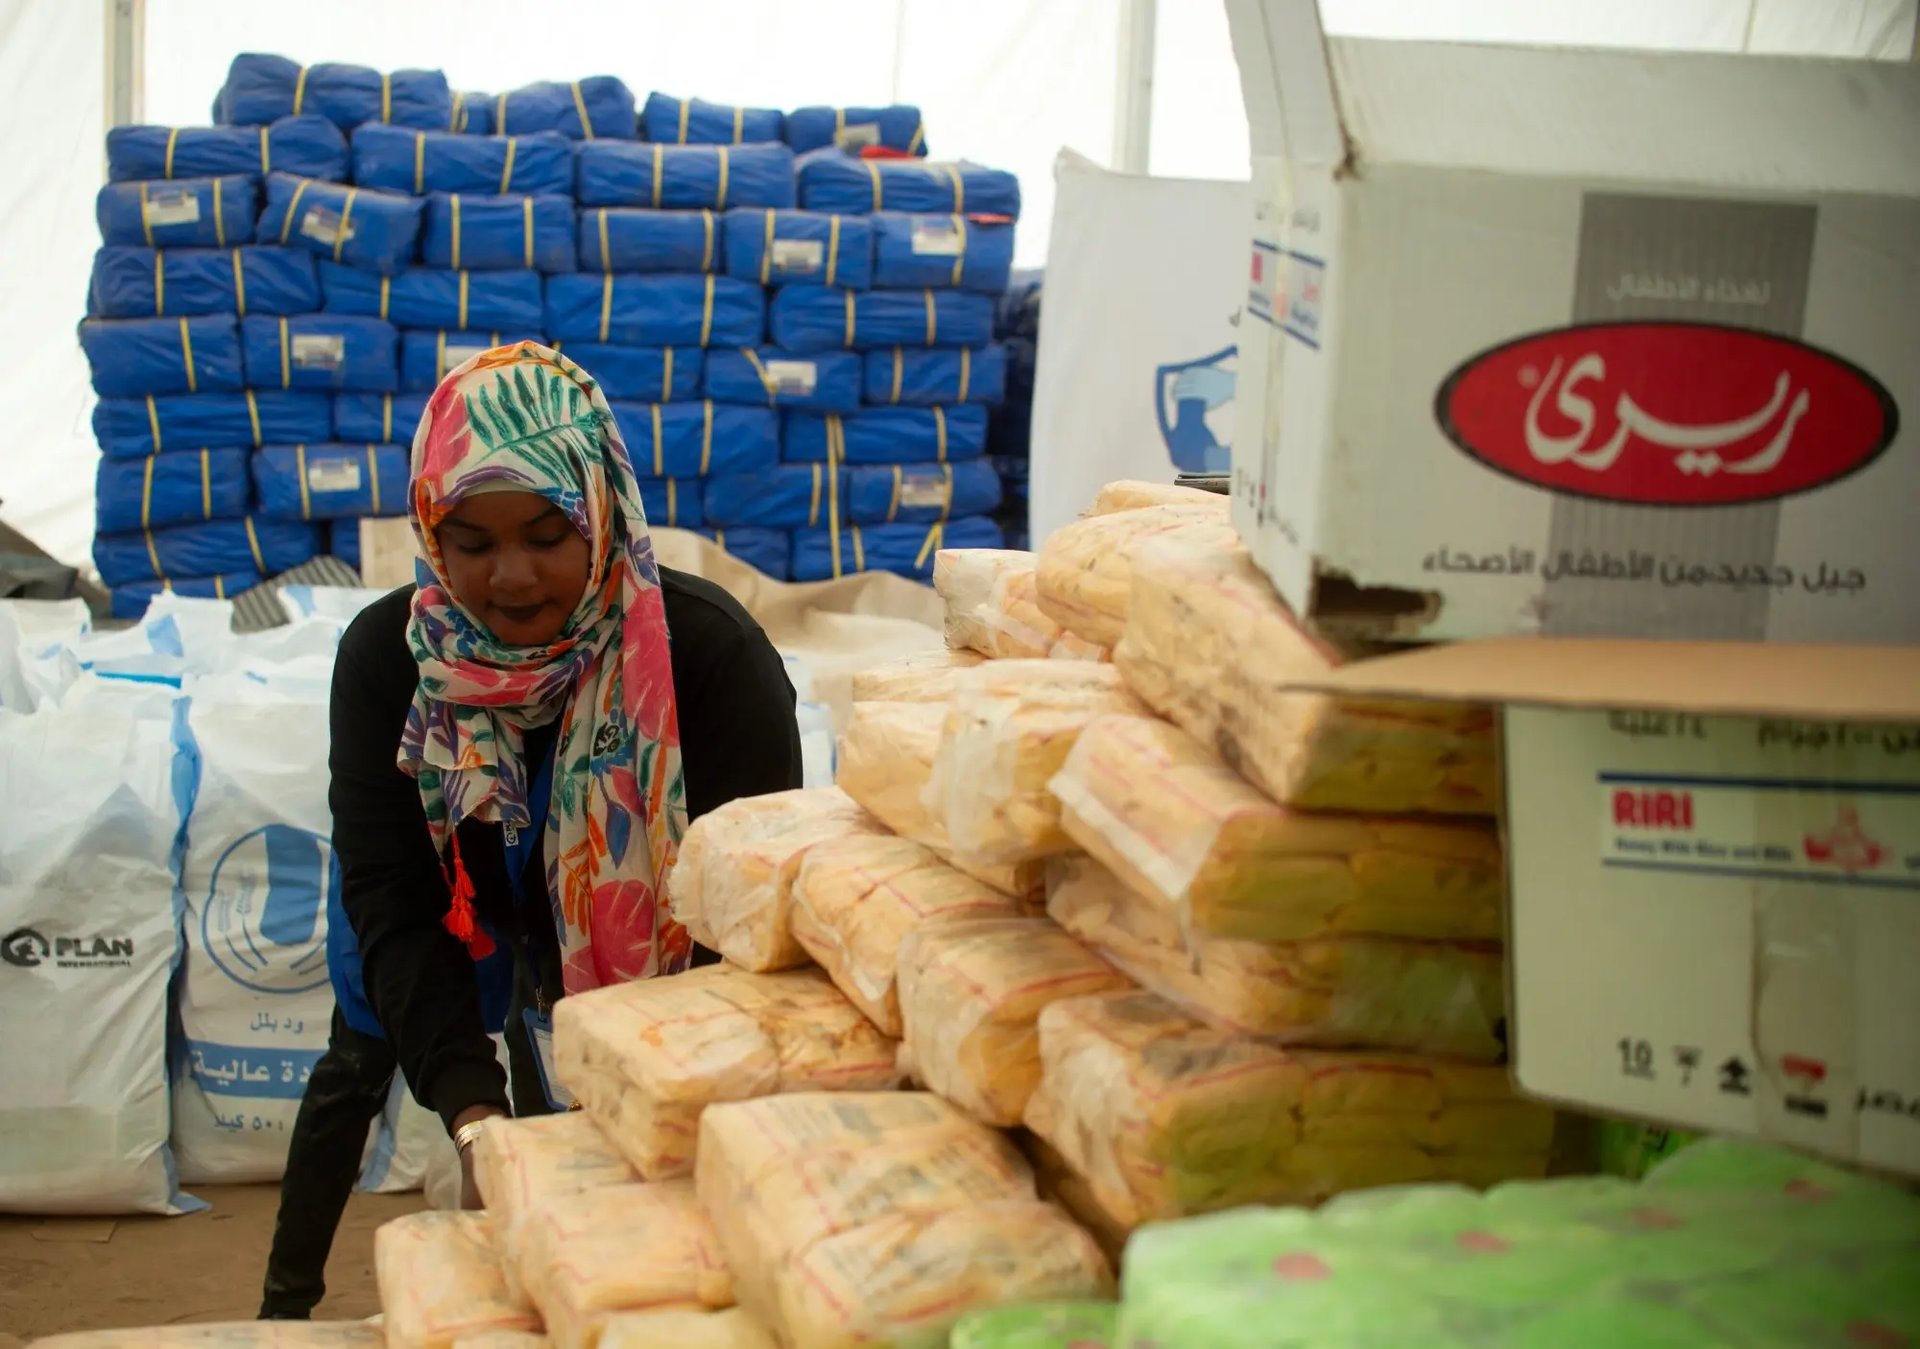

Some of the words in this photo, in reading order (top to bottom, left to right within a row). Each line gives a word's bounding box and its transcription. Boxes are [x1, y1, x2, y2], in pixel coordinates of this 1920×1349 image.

[1801, 560, 1867, 595] جيل
[1612, 788, 1695, 831] RIRI
[56, 938, 133, 956] PLAN
[191, 1050, 271, 1087] عالية
